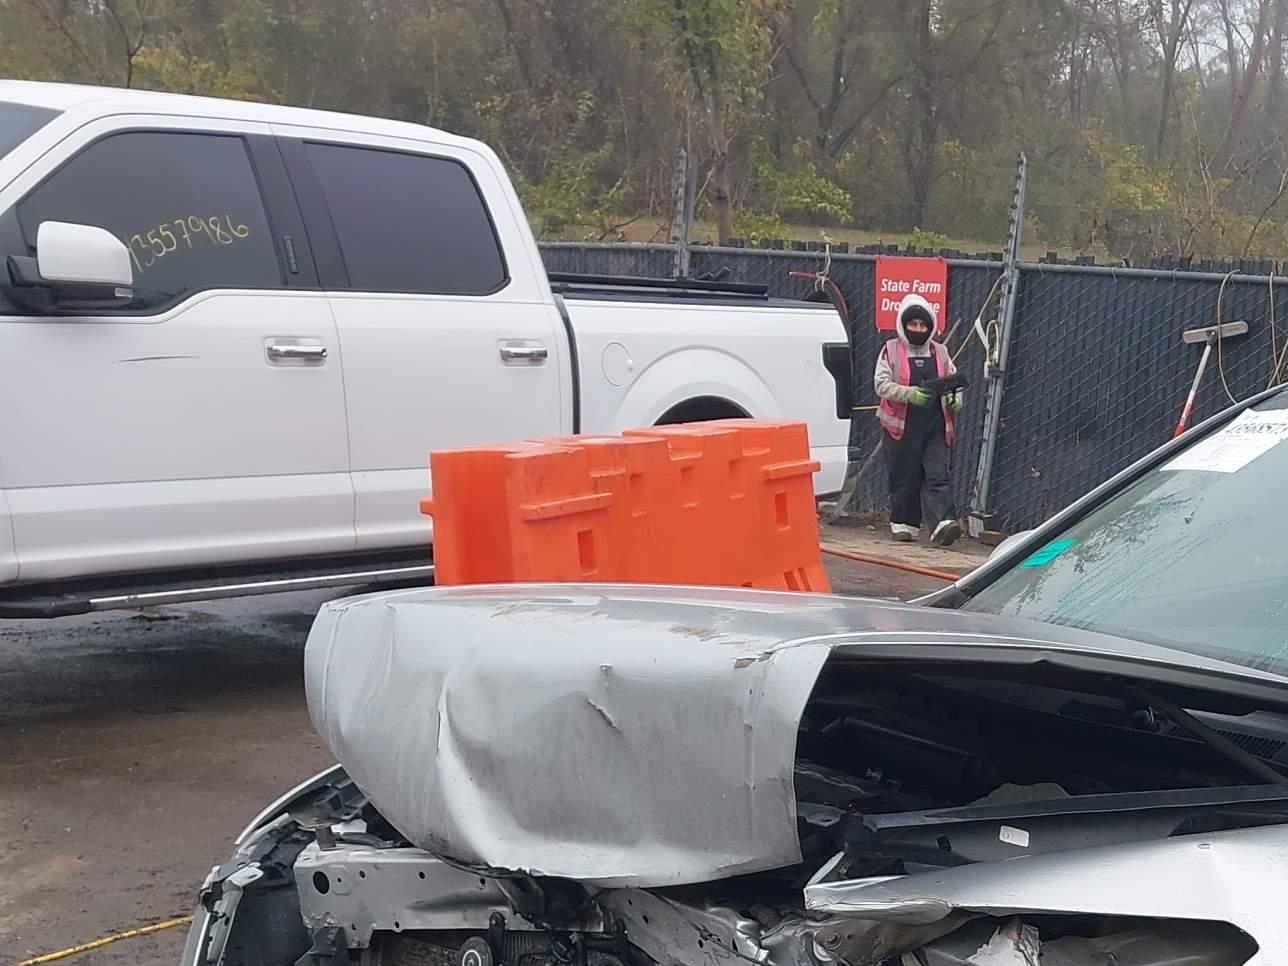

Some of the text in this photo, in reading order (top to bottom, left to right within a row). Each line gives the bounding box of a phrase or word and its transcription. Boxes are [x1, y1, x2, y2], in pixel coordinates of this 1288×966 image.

[881, 279, 941, 294] State Farm
[881, 298, 901, 312] Dro
